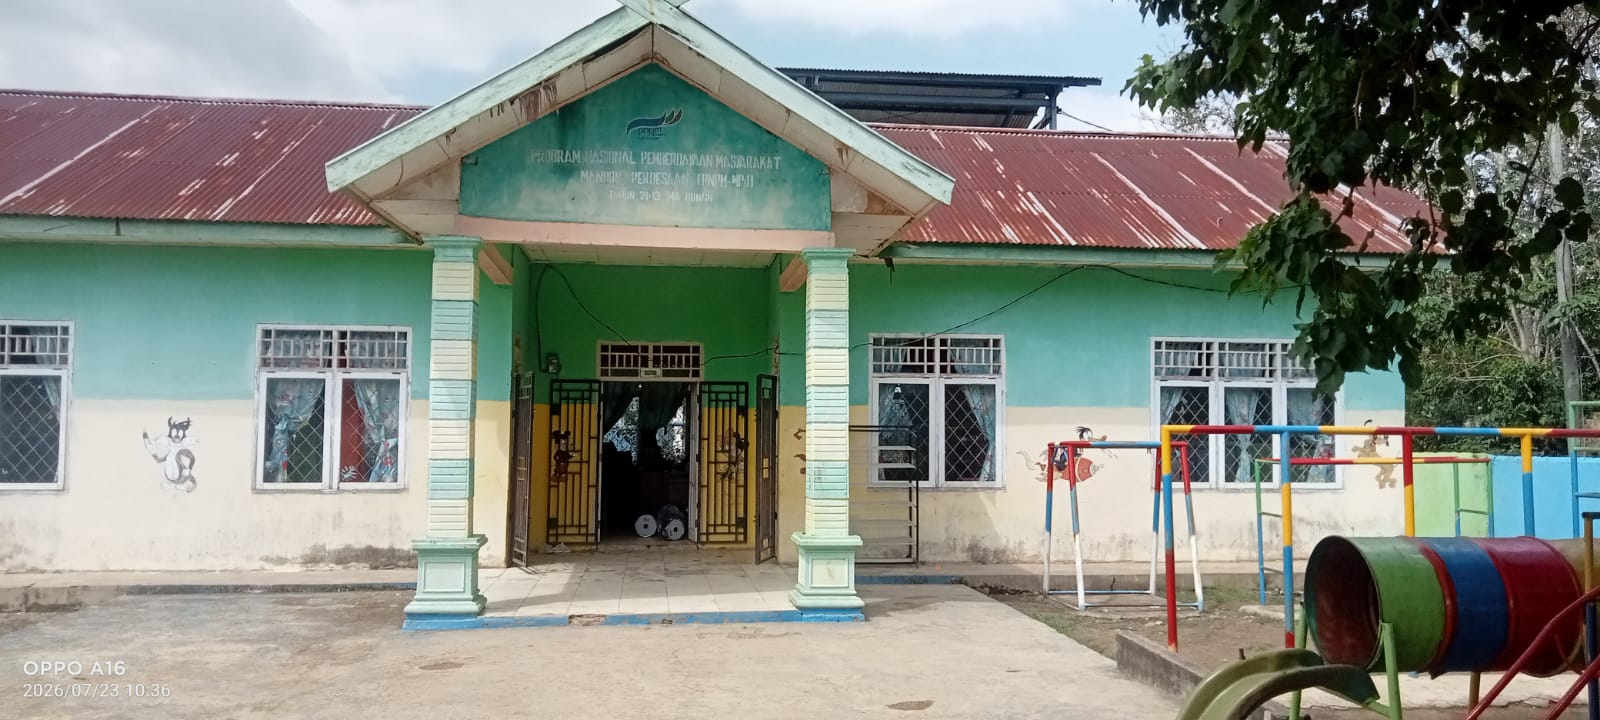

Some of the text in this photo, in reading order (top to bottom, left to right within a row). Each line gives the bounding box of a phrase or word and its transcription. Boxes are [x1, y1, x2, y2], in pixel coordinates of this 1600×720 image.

[640, 151, 713, 168] PEMBERDAYAAN
[715, 154, 782, 170] MASYARAKAT
[631, 171, 689, 185] PERDESAAN
